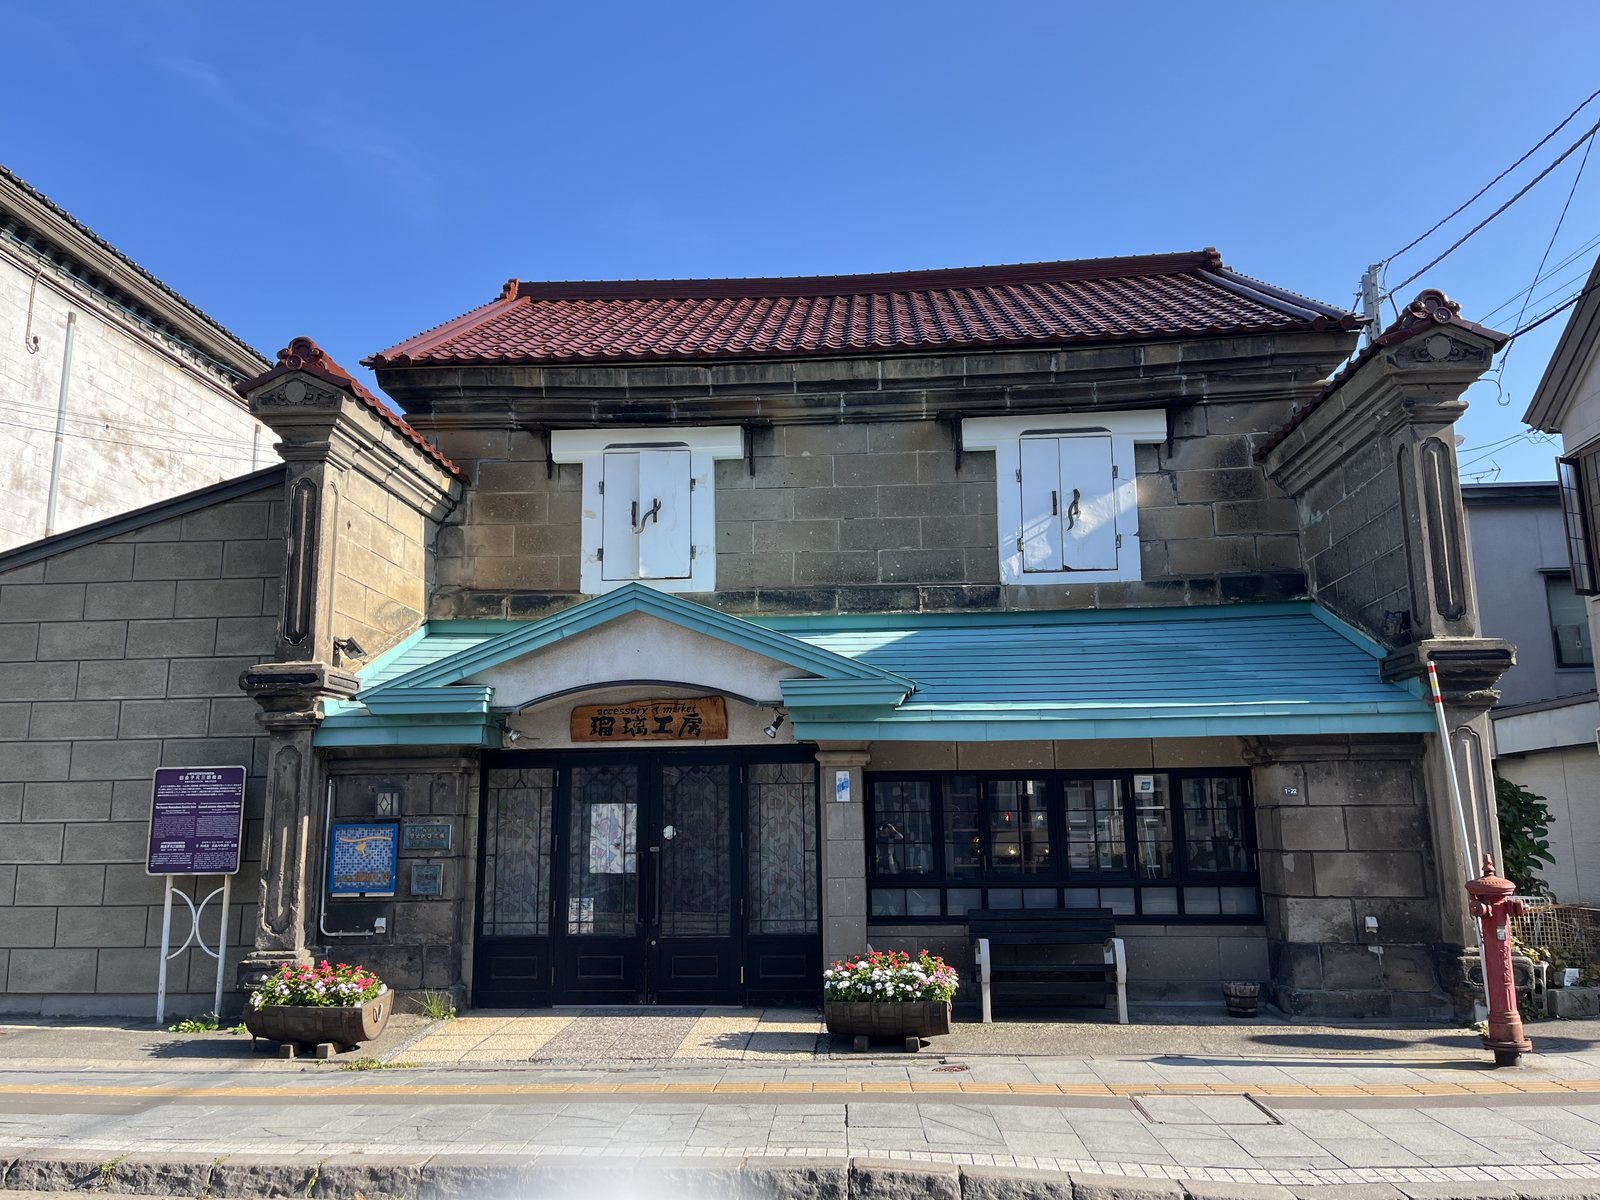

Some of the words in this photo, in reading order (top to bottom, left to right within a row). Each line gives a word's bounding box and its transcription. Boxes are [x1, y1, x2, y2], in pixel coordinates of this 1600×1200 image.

[597, 707, 648, 716] accessory
[662, 702, 697, 713] market
[589, 713, 702, 737] 瑠璃工房
